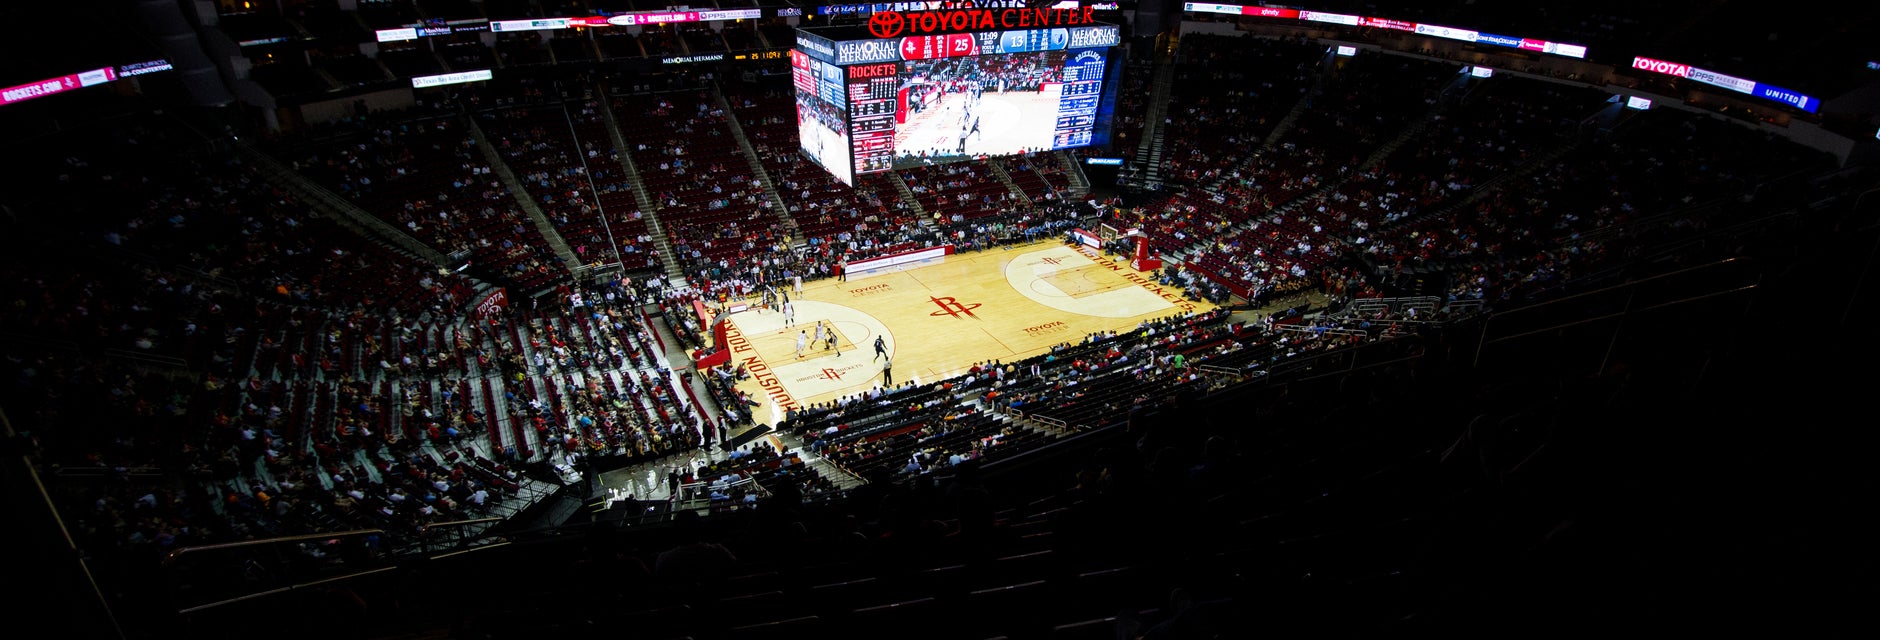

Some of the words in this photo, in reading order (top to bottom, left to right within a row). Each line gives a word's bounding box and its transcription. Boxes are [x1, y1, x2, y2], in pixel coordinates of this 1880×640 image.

[707, 12, 726, 20] PPS
[906, 9, 995, 33] TOYOTA
[1000, 5, 1095, 28] CENTER
[1260, 9, 1280, 17] xfinity
[979, 32, 998, 41] 11:09
[1072, 27, 1117, 38] MEMORIAL
[954, 38, 969, 52] 25
[1011, 36, 1024, 48] 13
[1071, 35, 1116, 47] HERMANN
[839, 41, 896, 54] MEMORIAL
[663, 56, 692, 64] MEMORIAL
[694, 54, 723, 63] HERMANN
[839, 49, 896, 63] HERMANN
[850, 63, 896, 79] ROCKETS
[1633, 57, 1686, 77] TOYOTA
[1695, 71, 1714, 83] PPS
[1765, 88, 1799, 105] UNITED
[848, 283, 889, 294] TOYOTA
[1122, 272, 1197, 311] ROCKETS
[477, 291, 505, 315] TOYOTA
[1022, 321, 1065, 333] TOYOTA
